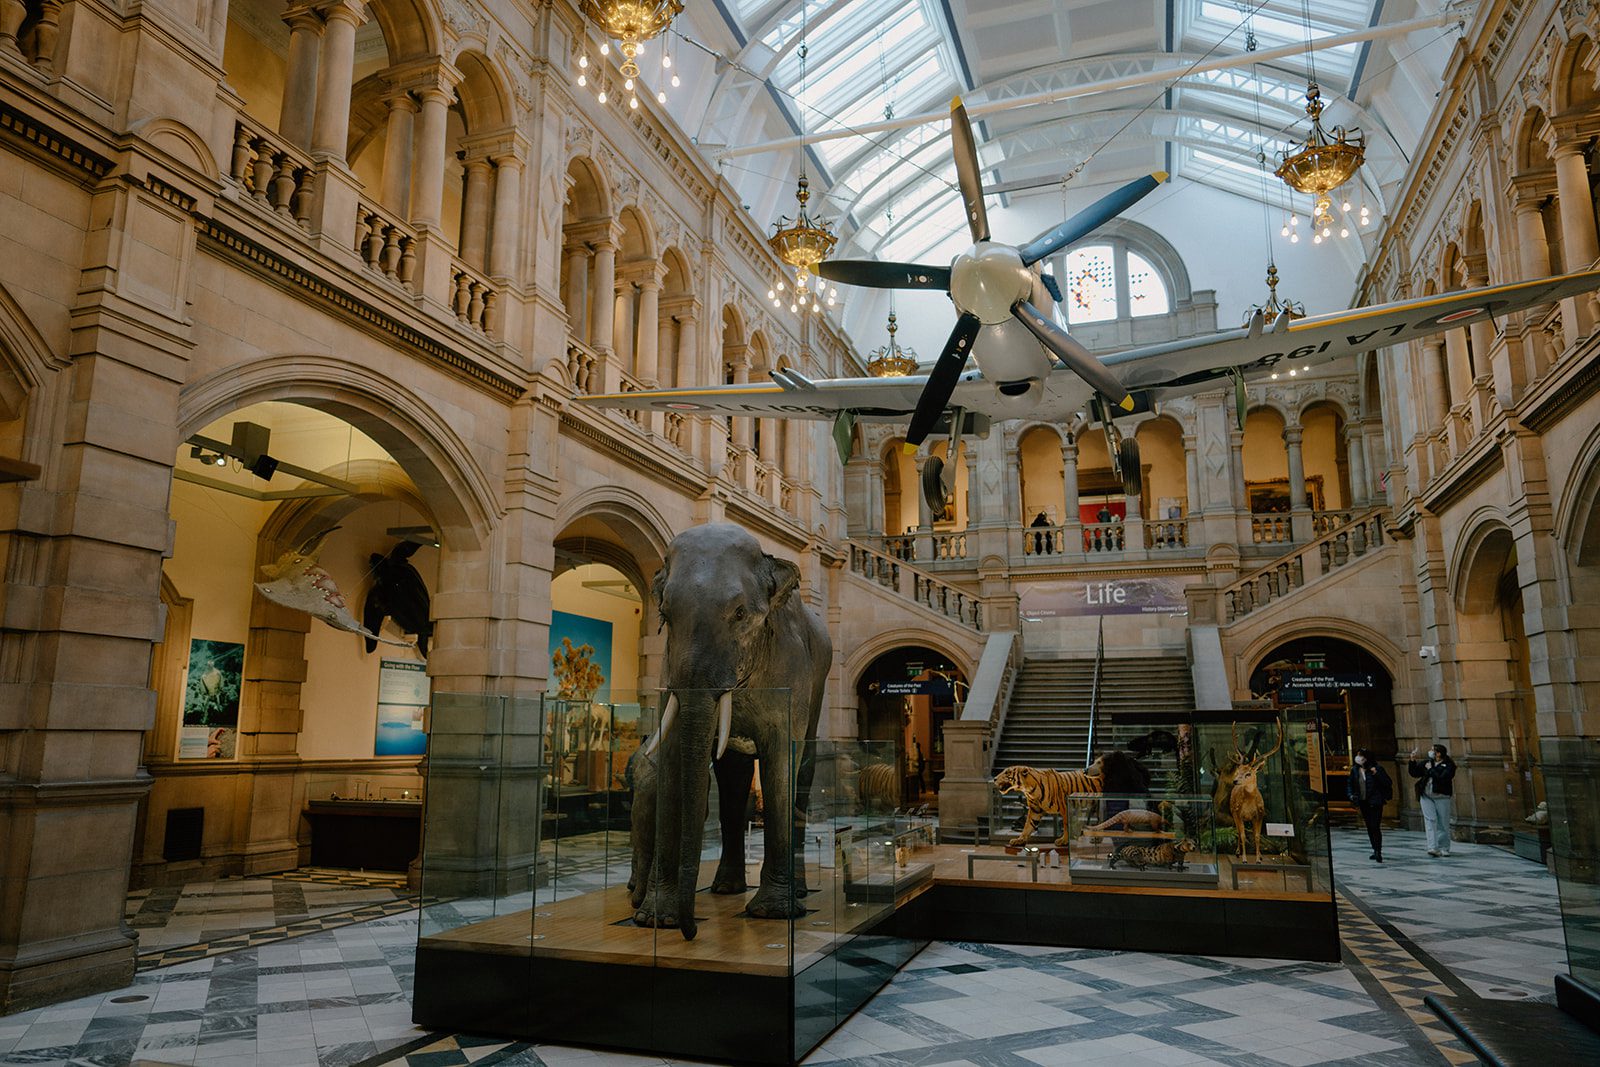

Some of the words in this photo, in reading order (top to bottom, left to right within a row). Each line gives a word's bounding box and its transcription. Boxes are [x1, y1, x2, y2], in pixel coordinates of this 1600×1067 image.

[1346, 323, 1407, 346] LA
[1086, 583, 1126, 604] Life
[1157, 605, 1177, 613] Discovery
